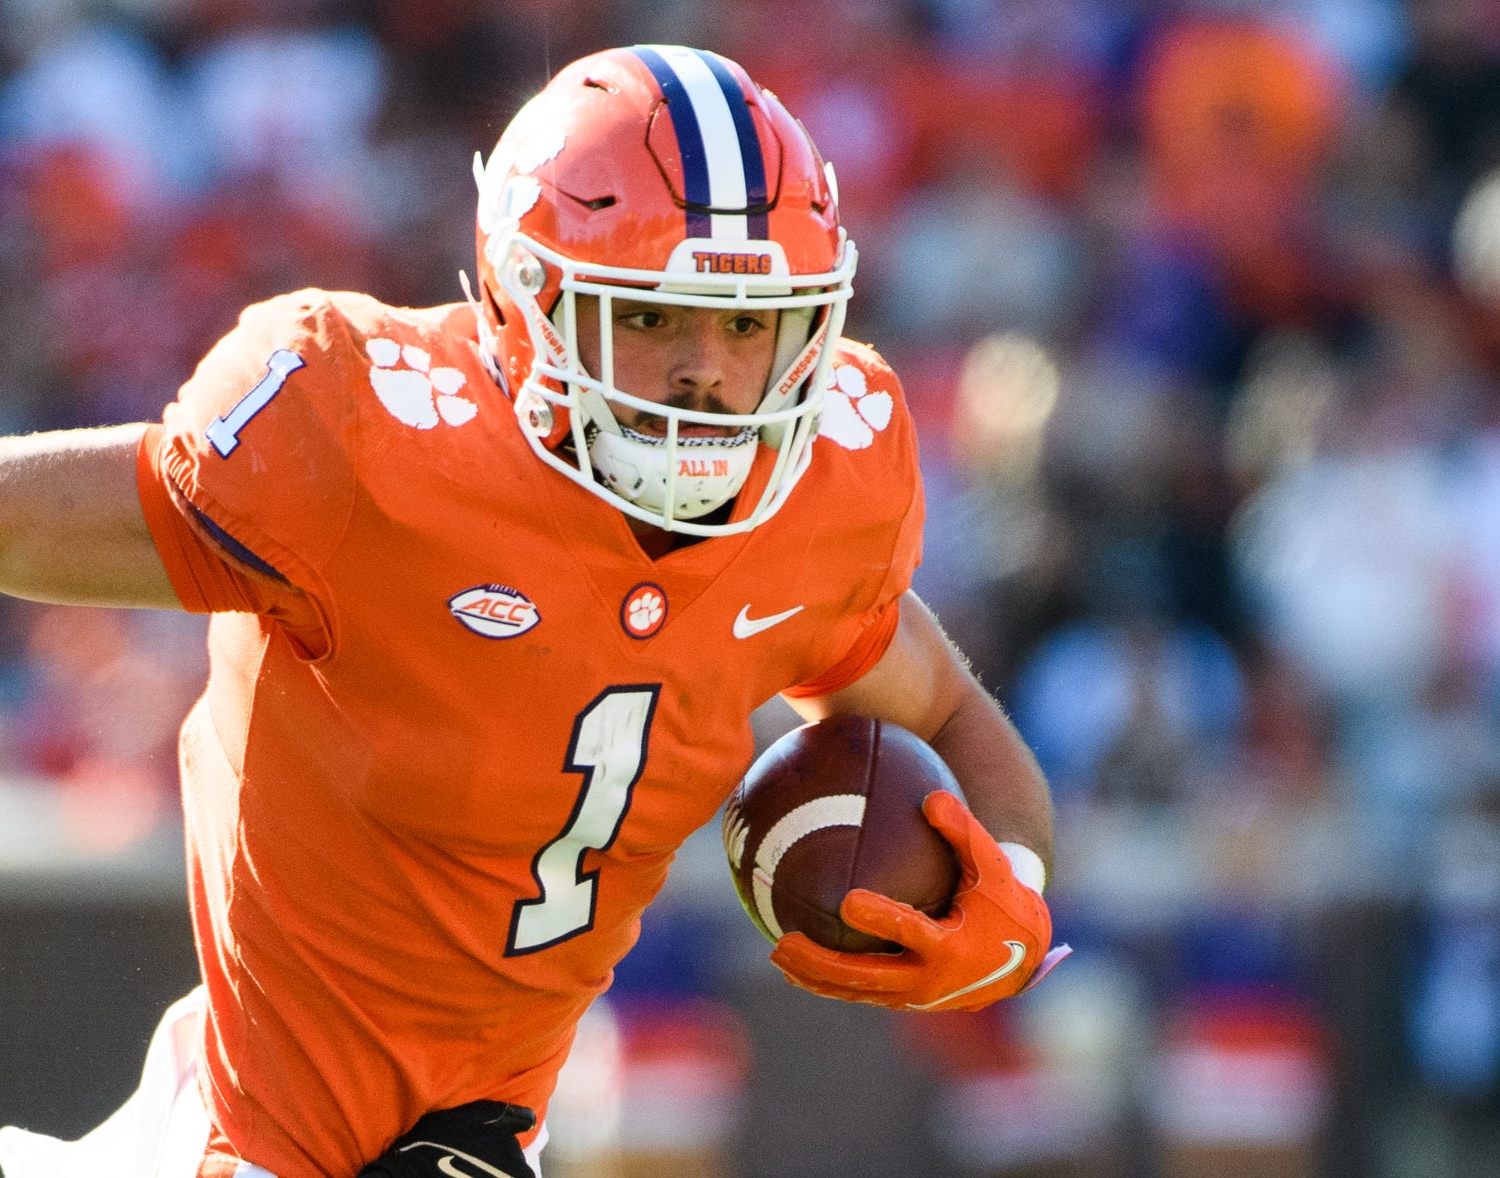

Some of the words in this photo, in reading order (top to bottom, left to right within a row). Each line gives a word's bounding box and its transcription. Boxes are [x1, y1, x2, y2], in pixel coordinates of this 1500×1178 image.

[693, 252, 772, 275] TIGERS
[779, 347, 818, 395] CLEMSON
[205, 349, 307, 460] 1
[678, 460, 710, 476] ALL
[713, 460, 728, 476] IN
[460, 598, 530, 621] ACC
[503, 683, 662, 957] 1
